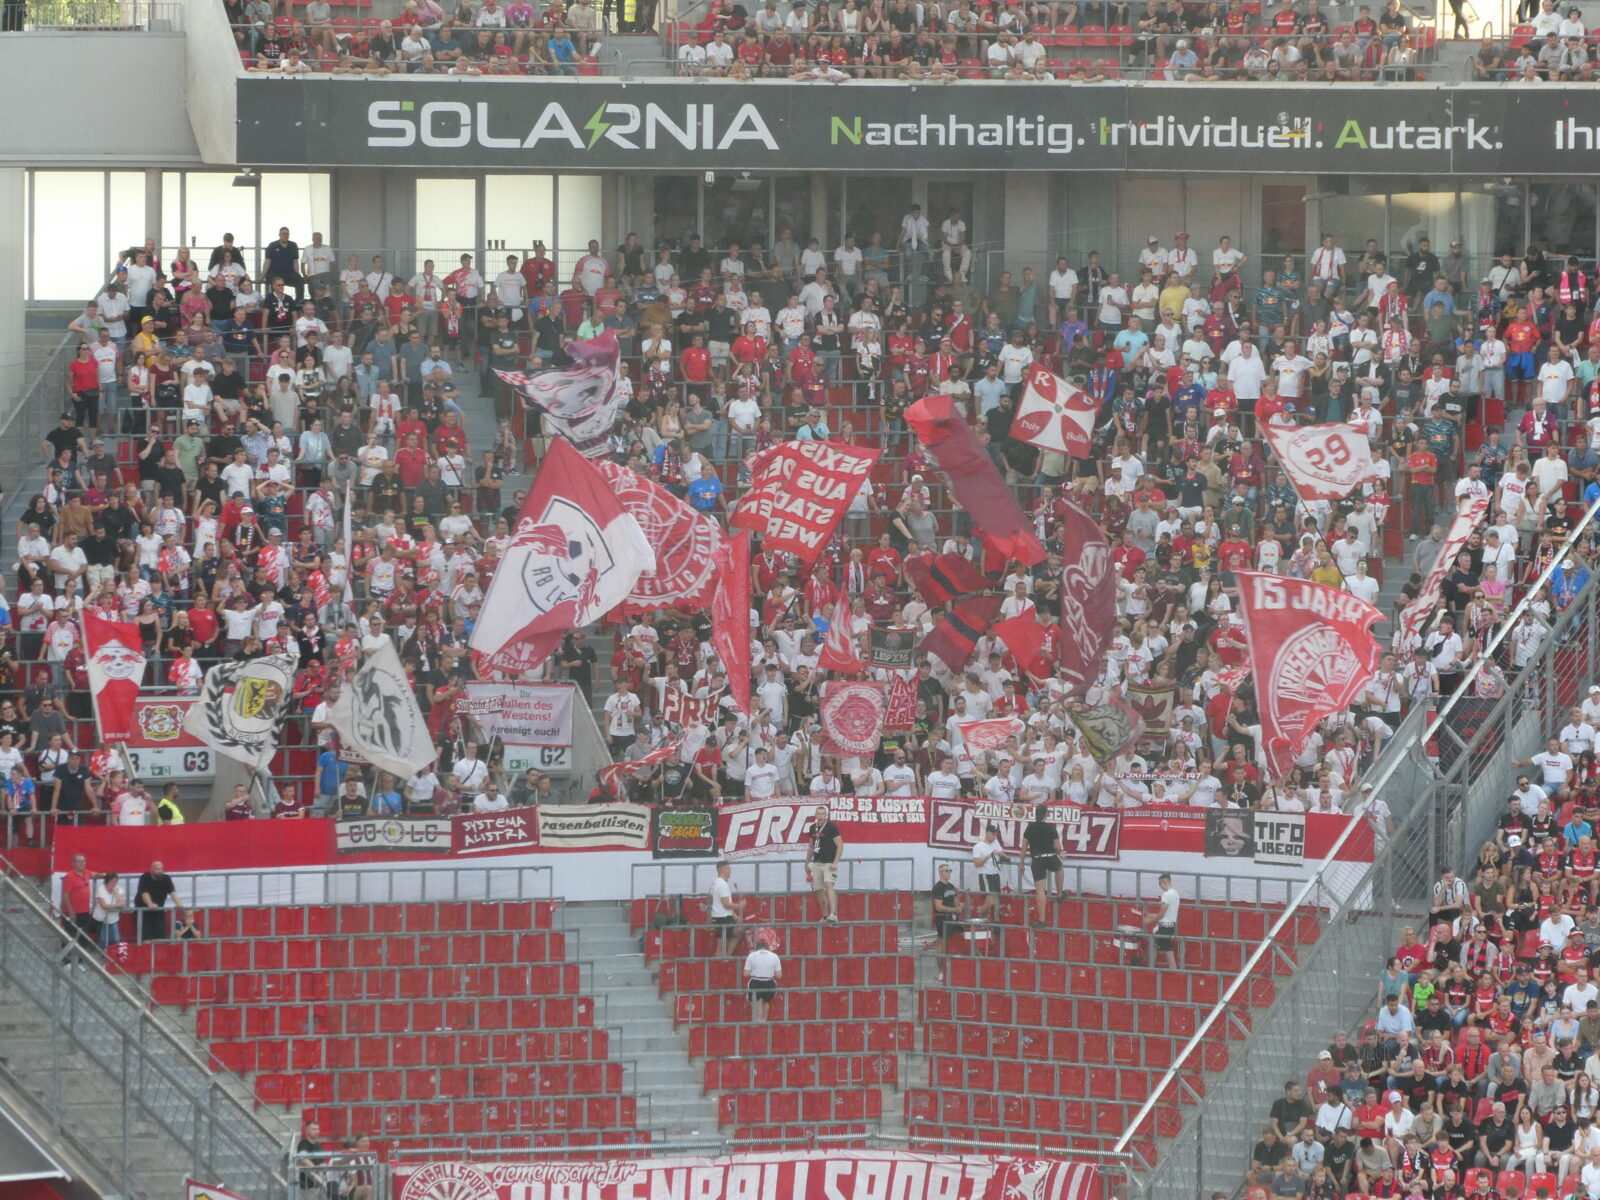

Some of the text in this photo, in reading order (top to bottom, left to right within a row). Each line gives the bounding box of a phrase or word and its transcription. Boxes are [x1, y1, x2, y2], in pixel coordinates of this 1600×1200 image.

[367, 101, 780, 151] SOLARNIA
[831, 114, 1600, 154] Nachhaltig. Individuell. Autark. Ih
[1253, 577, 1287, 610] 15
[534, 700, 553, 710] des
[501, 711, 552, 722] Westens!
[534, 728, 561, 737] euch!
[183, 751, 209, 772] G3
[540, 747, 566, 766] G2
[858, 798, 873, 811] ES
[877, 799, 925, 812] KOSTET
[975, 803, 1081, 823] ZONE JGEND
[462, 815, 527, 832] SYSTEMA
[541, 816, 645, 832] rasenballisten
[936, 805, 1032, 848] ZON
[1255, 822, 1305, 843] TIFO
[464, 829, 528, 847] ALISTRA
[1254, 842, 1303, 857] LIBERO
[493, 1159, 638, 1189] gemeinsam für
